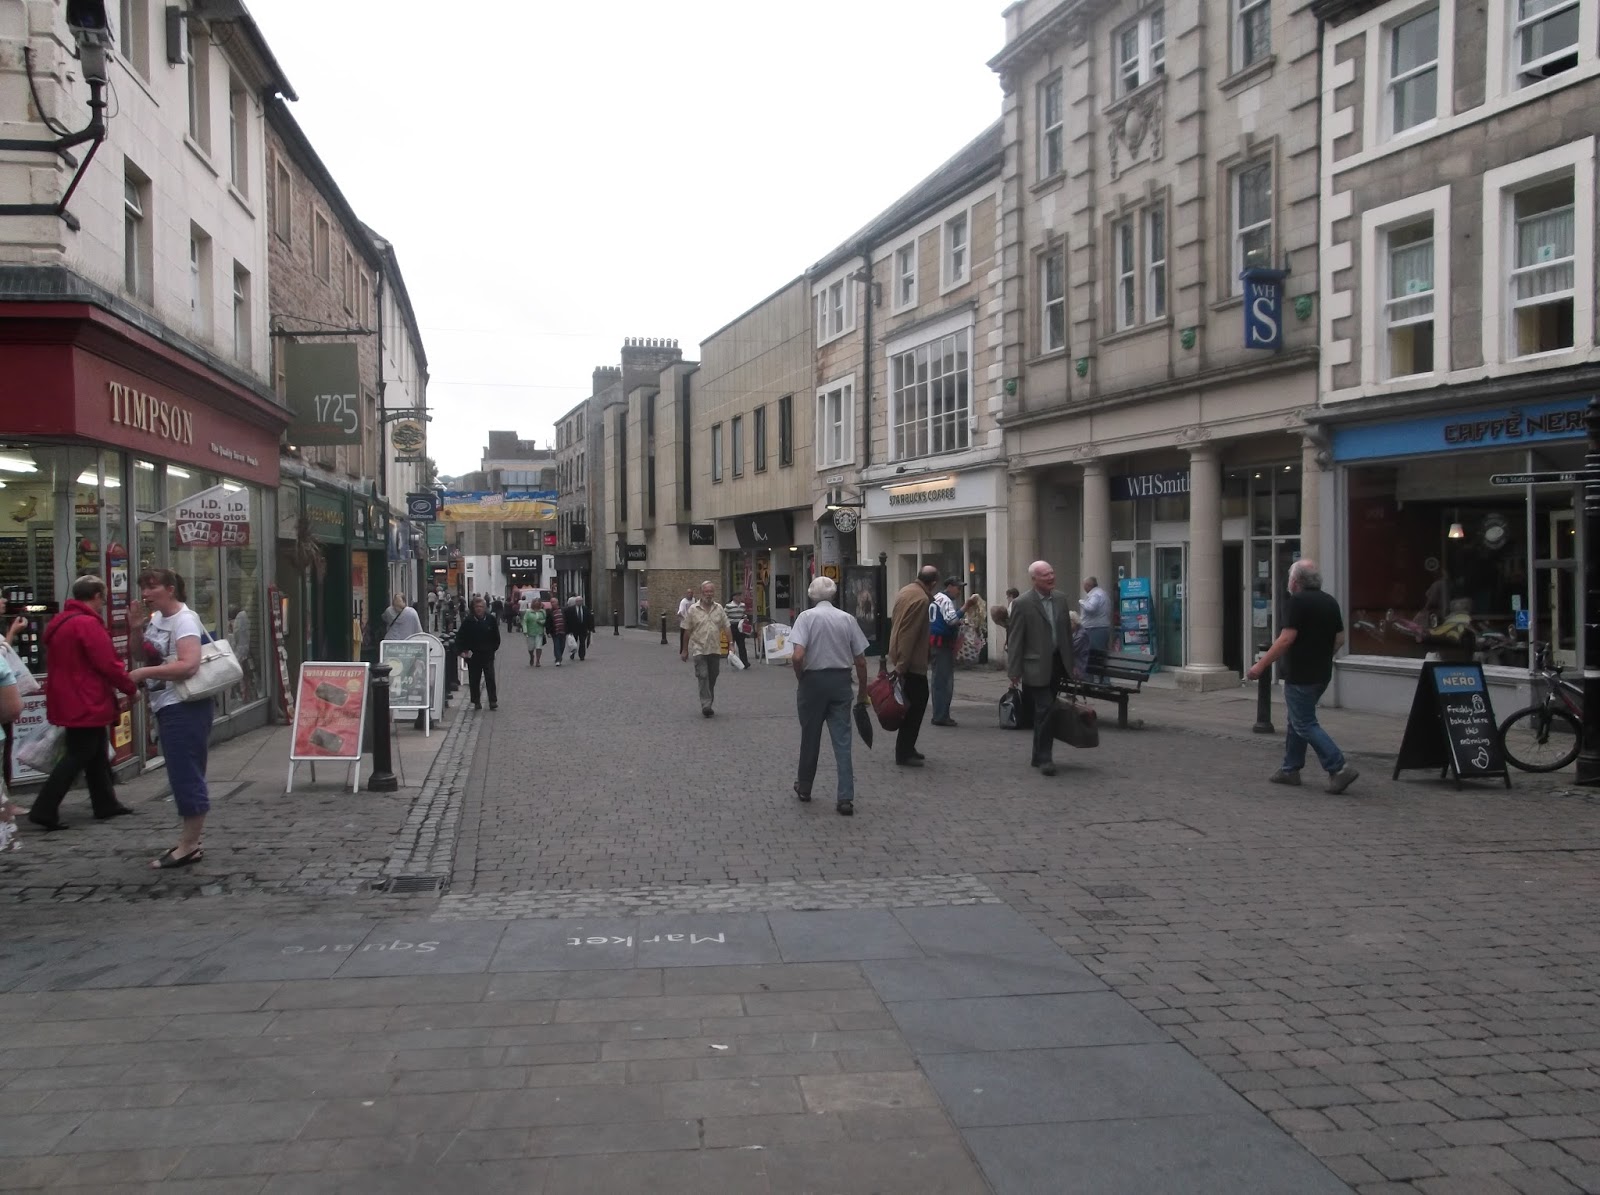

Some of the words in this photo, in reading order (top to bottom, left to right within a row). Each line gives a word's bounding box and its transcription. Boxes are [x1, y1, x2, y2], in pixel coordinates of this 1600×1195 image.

[1252, 283, 1276, 298] WH
[1252, 297, 1278, 343] S
[109, 380, 194, 446] TIMPSON
[313, 394, 359, 434] 1725
[889, 490, 928, 507] STARBUCKS
[927, 486, 957, 502] COFFEE
[180, 508, 221, 520] Photos
[223, 513, 247, 521] otos
[509, 559, 538, 567] LUSH
[1442, 676, 1476, 686] NERO
[1465, 727, 1479, 735] this
[1460, 737, 1491, 746] morning
[281, 939, 441, 954] Square
[566, 932, 726, 947] Market
